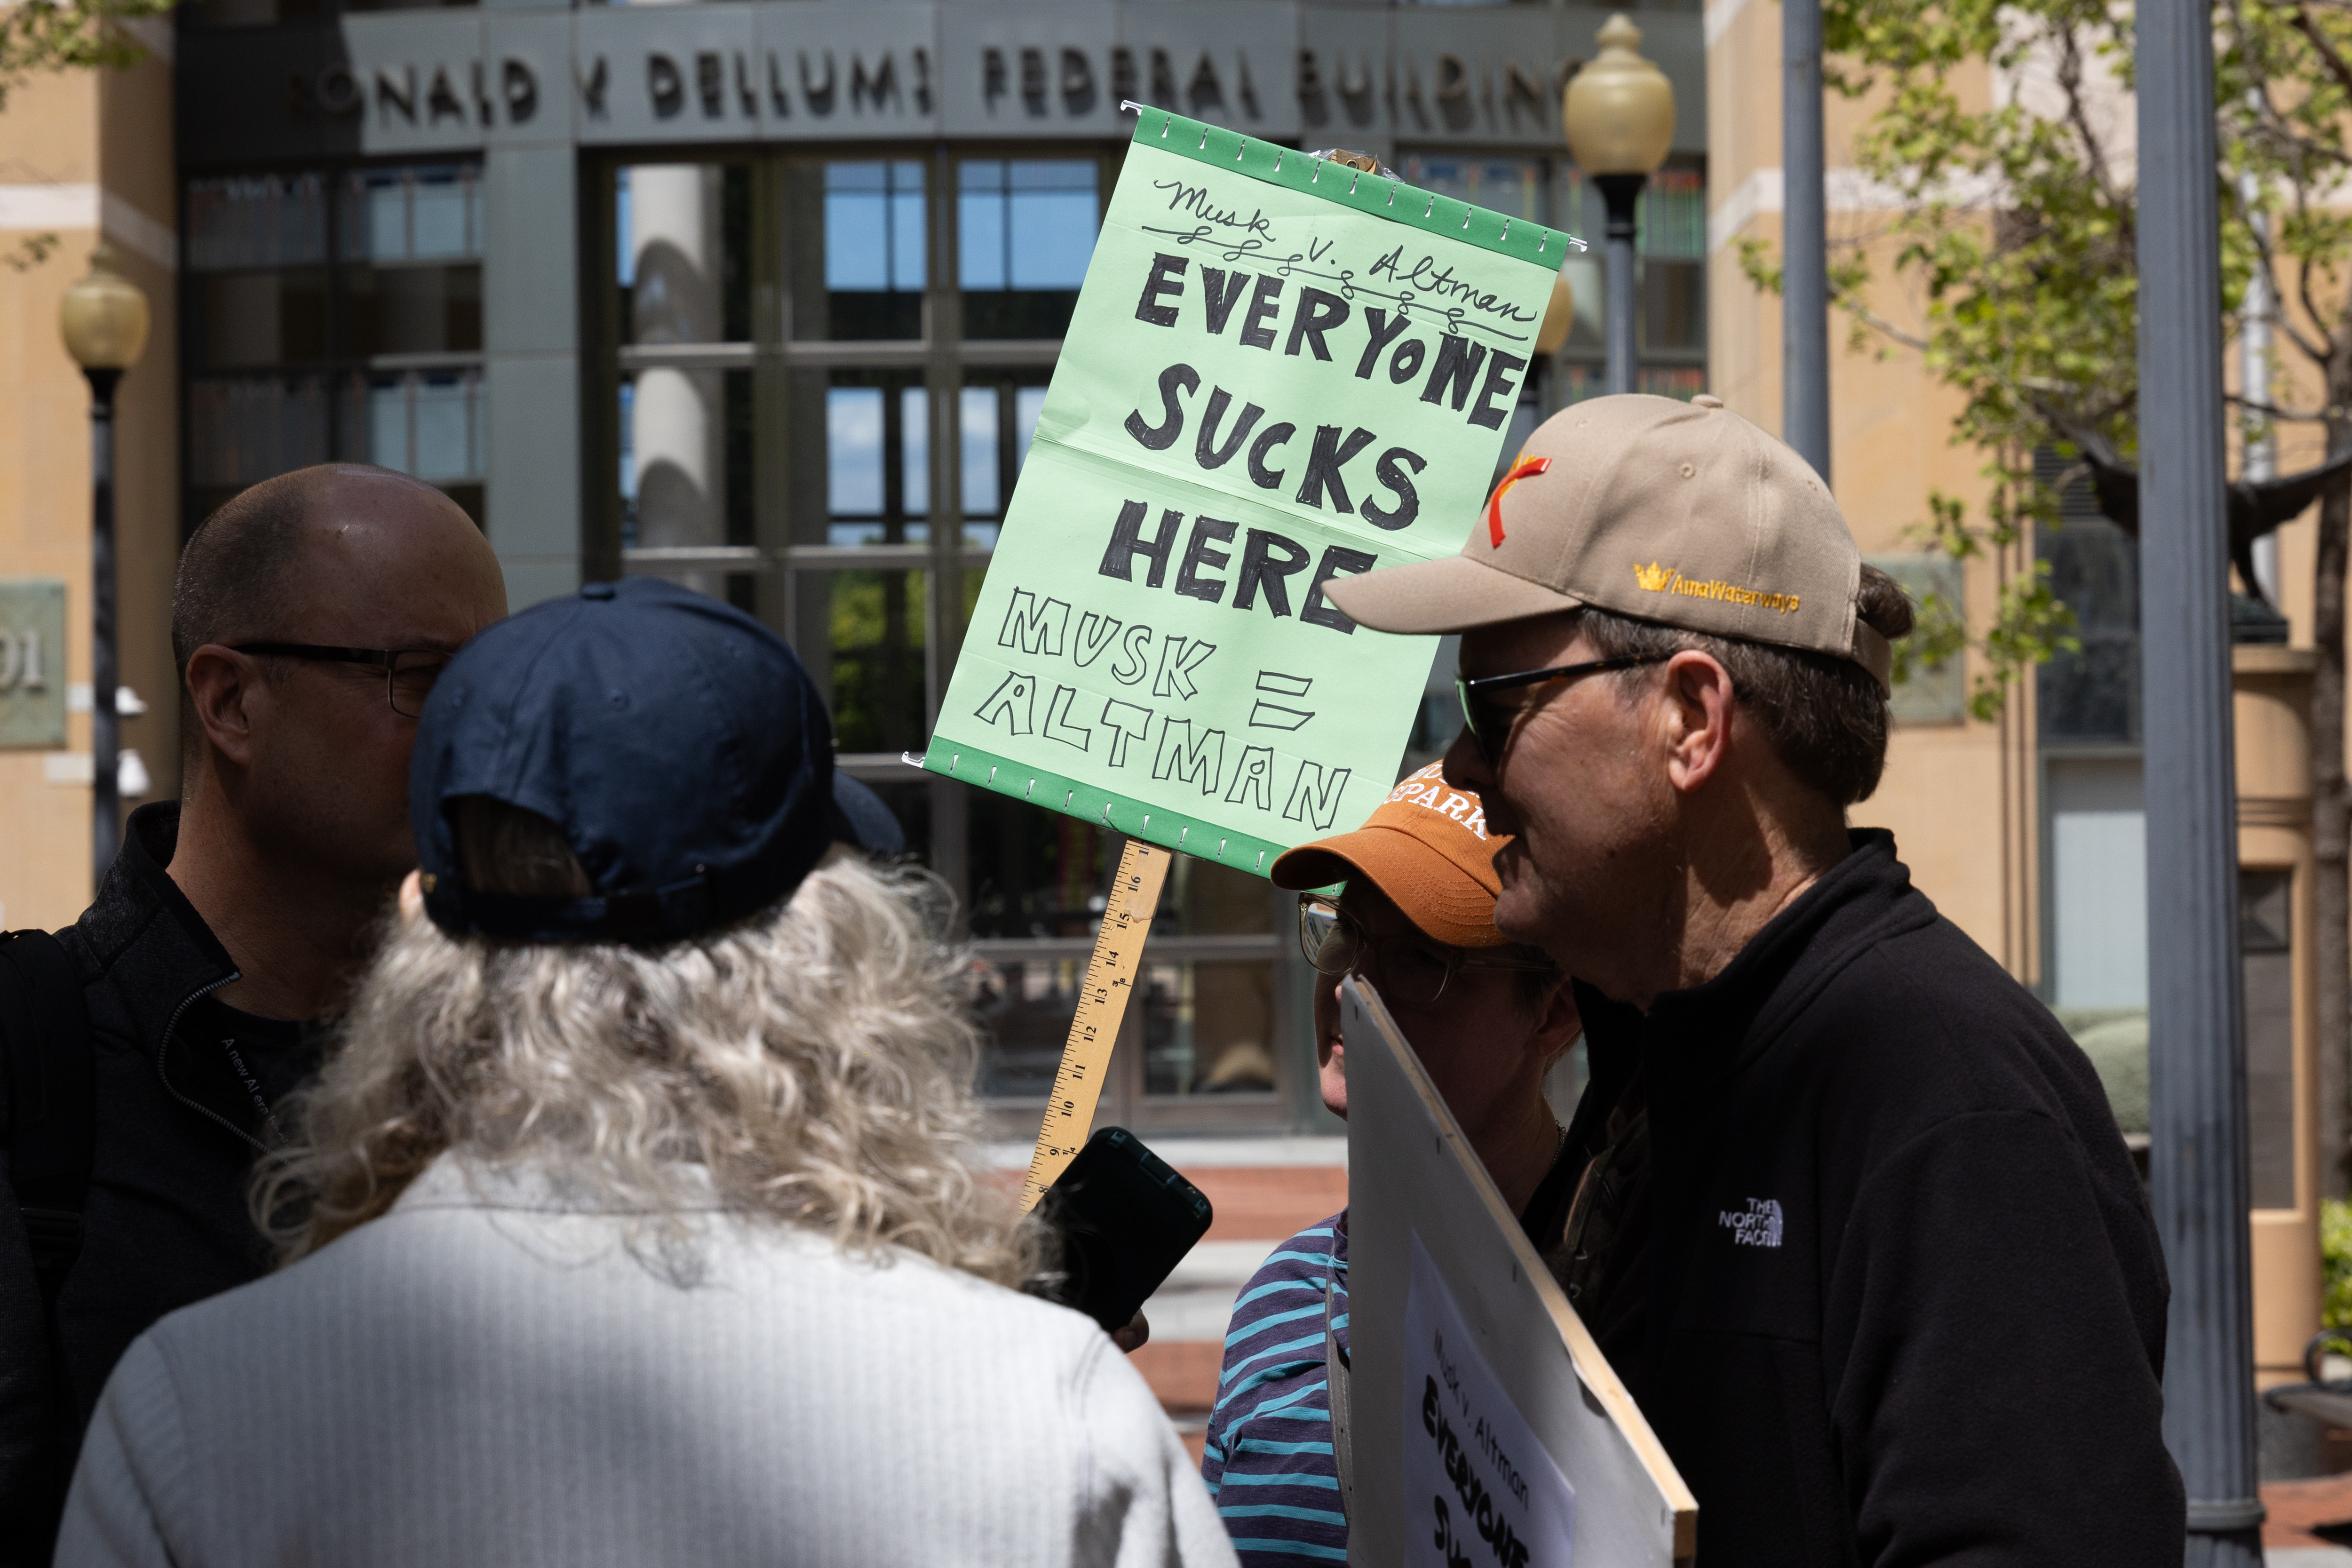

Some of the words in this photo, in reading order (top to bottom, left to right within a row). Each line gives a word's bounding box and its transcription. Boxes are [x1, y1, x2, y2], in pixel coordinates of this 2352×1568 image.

[1153, 179, 1277, 243] Musk
[1369, 244, 1537, 322] Altman
[1134, 251, 1528, 432] EVERYONE
[1124, 363, 1428, 530] SUCKS
[1098, 499, 1378, 636] HERE
[997, 586, 1217, 702] MUSK
[972, 670, 1353, 832] ALTMAN
[1128, 875, 1141, 893] 16
[1117, 912, 1130, 931] 15
[1106, 950, 1119, 968] 14
[1094, 988, 1108, 1005] 13
[1083, 1026, 1097, 1043] 12
[228, 1050, 249, 1076] new
[254, 1095, 269, 1114] era
[1073, 1064, 1086, 1081] 11
[1061, 1101, 1074, 1118] 10
[1049, 1148, 1060, 1157] 9
[1746, 1197, 1773, 1214] THE
[1718, 1210, 1771, 1230] NORTH
[1474, 1415, 1528, 1512] Altman
